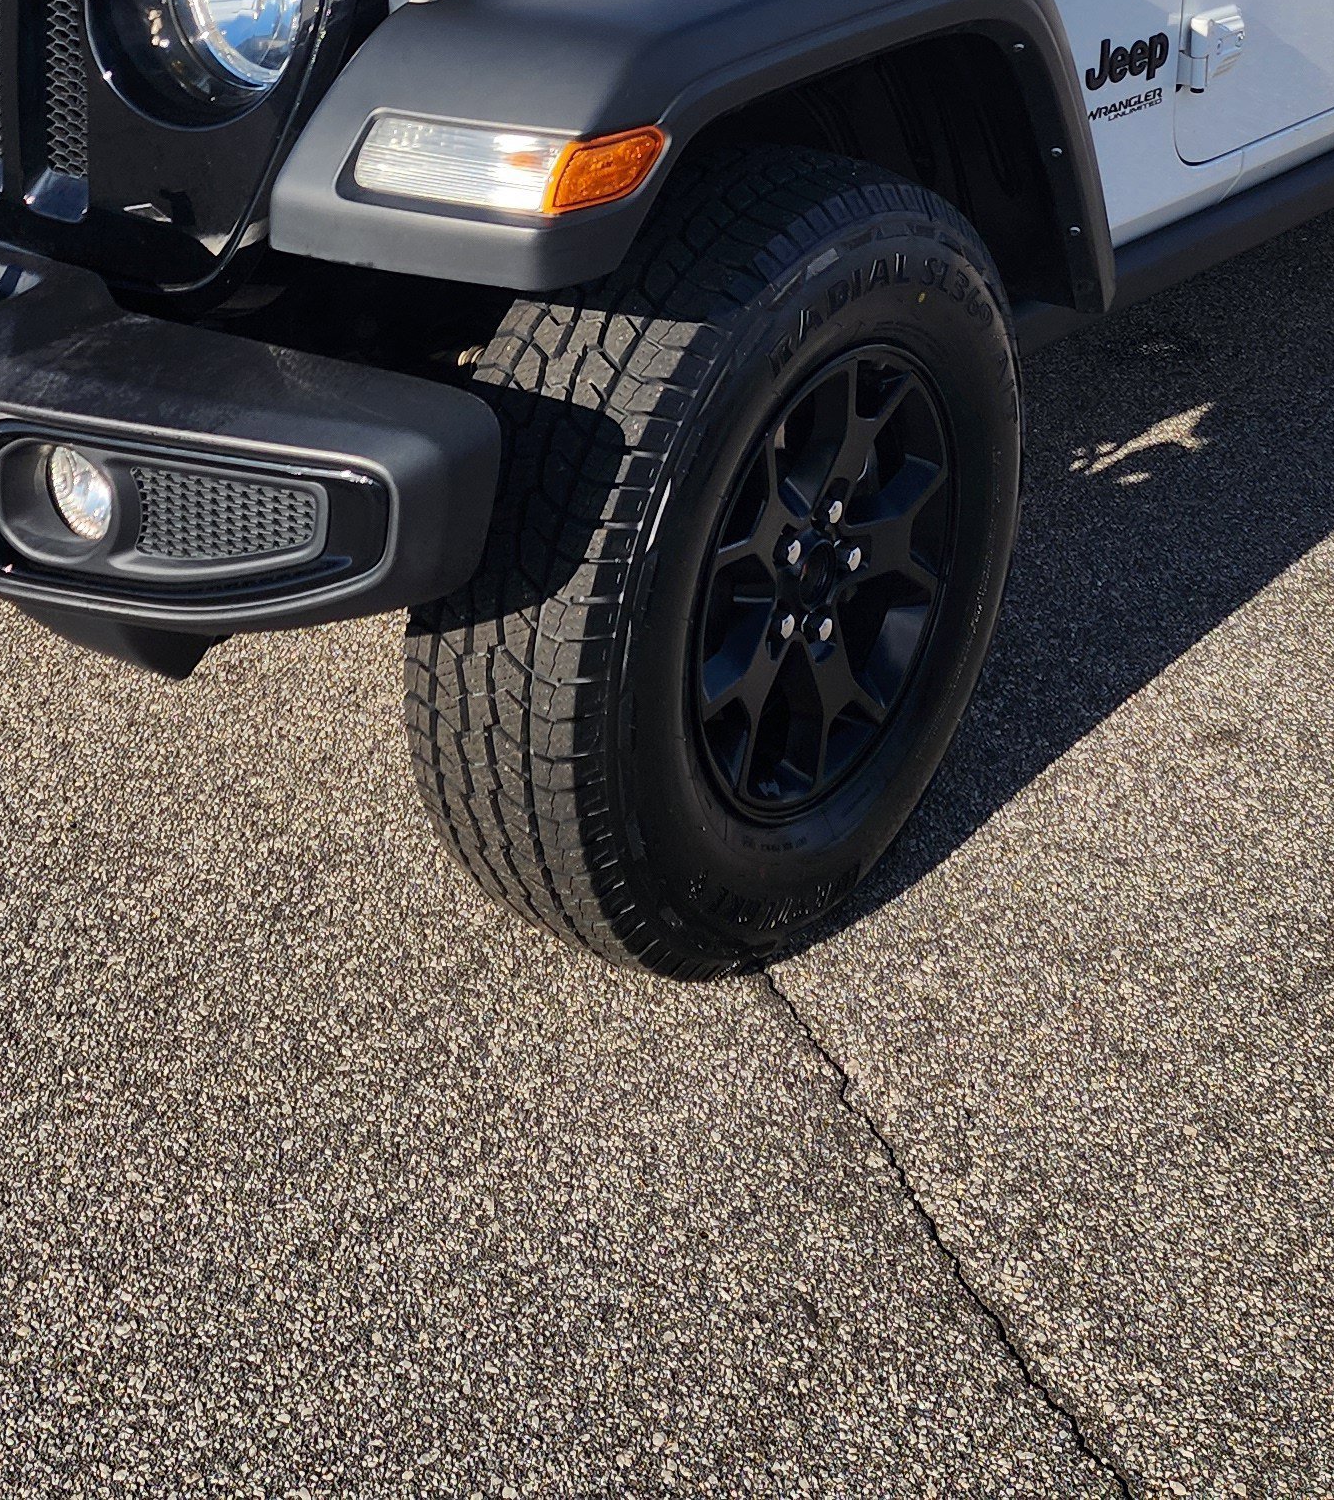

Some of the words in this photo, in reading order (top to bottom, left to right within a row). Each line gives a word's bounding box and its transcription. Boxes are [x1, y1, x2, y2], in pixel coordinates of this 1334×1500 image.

[1085, 32, 1169, 91] Jeep
[1088, 87, 1163, 121] WRANGLER
[1108, 98, 1163, 122] UNLIMITED
[765, 252, 912, 376] RADIAL
